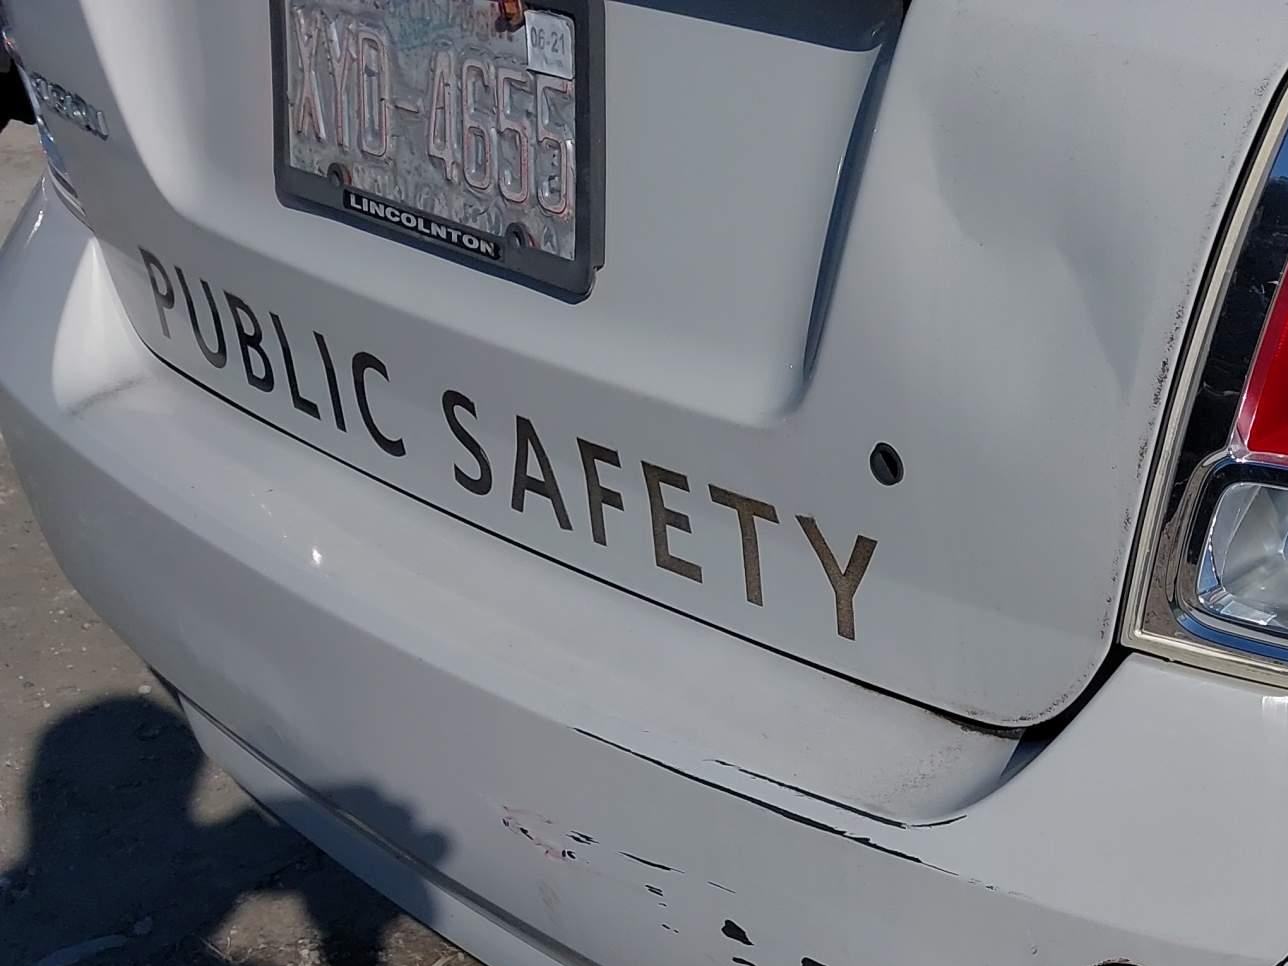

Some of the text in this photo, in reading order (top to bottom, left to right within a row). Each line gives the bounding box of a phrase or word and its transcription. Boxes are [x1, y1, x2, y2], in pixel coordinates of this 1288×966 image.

[530, 26, 566, 55] 06-21
[349, 193, 496, 257] LINCOLNTON
[138, 245, 878, 641] PUBLIC SAFETY
